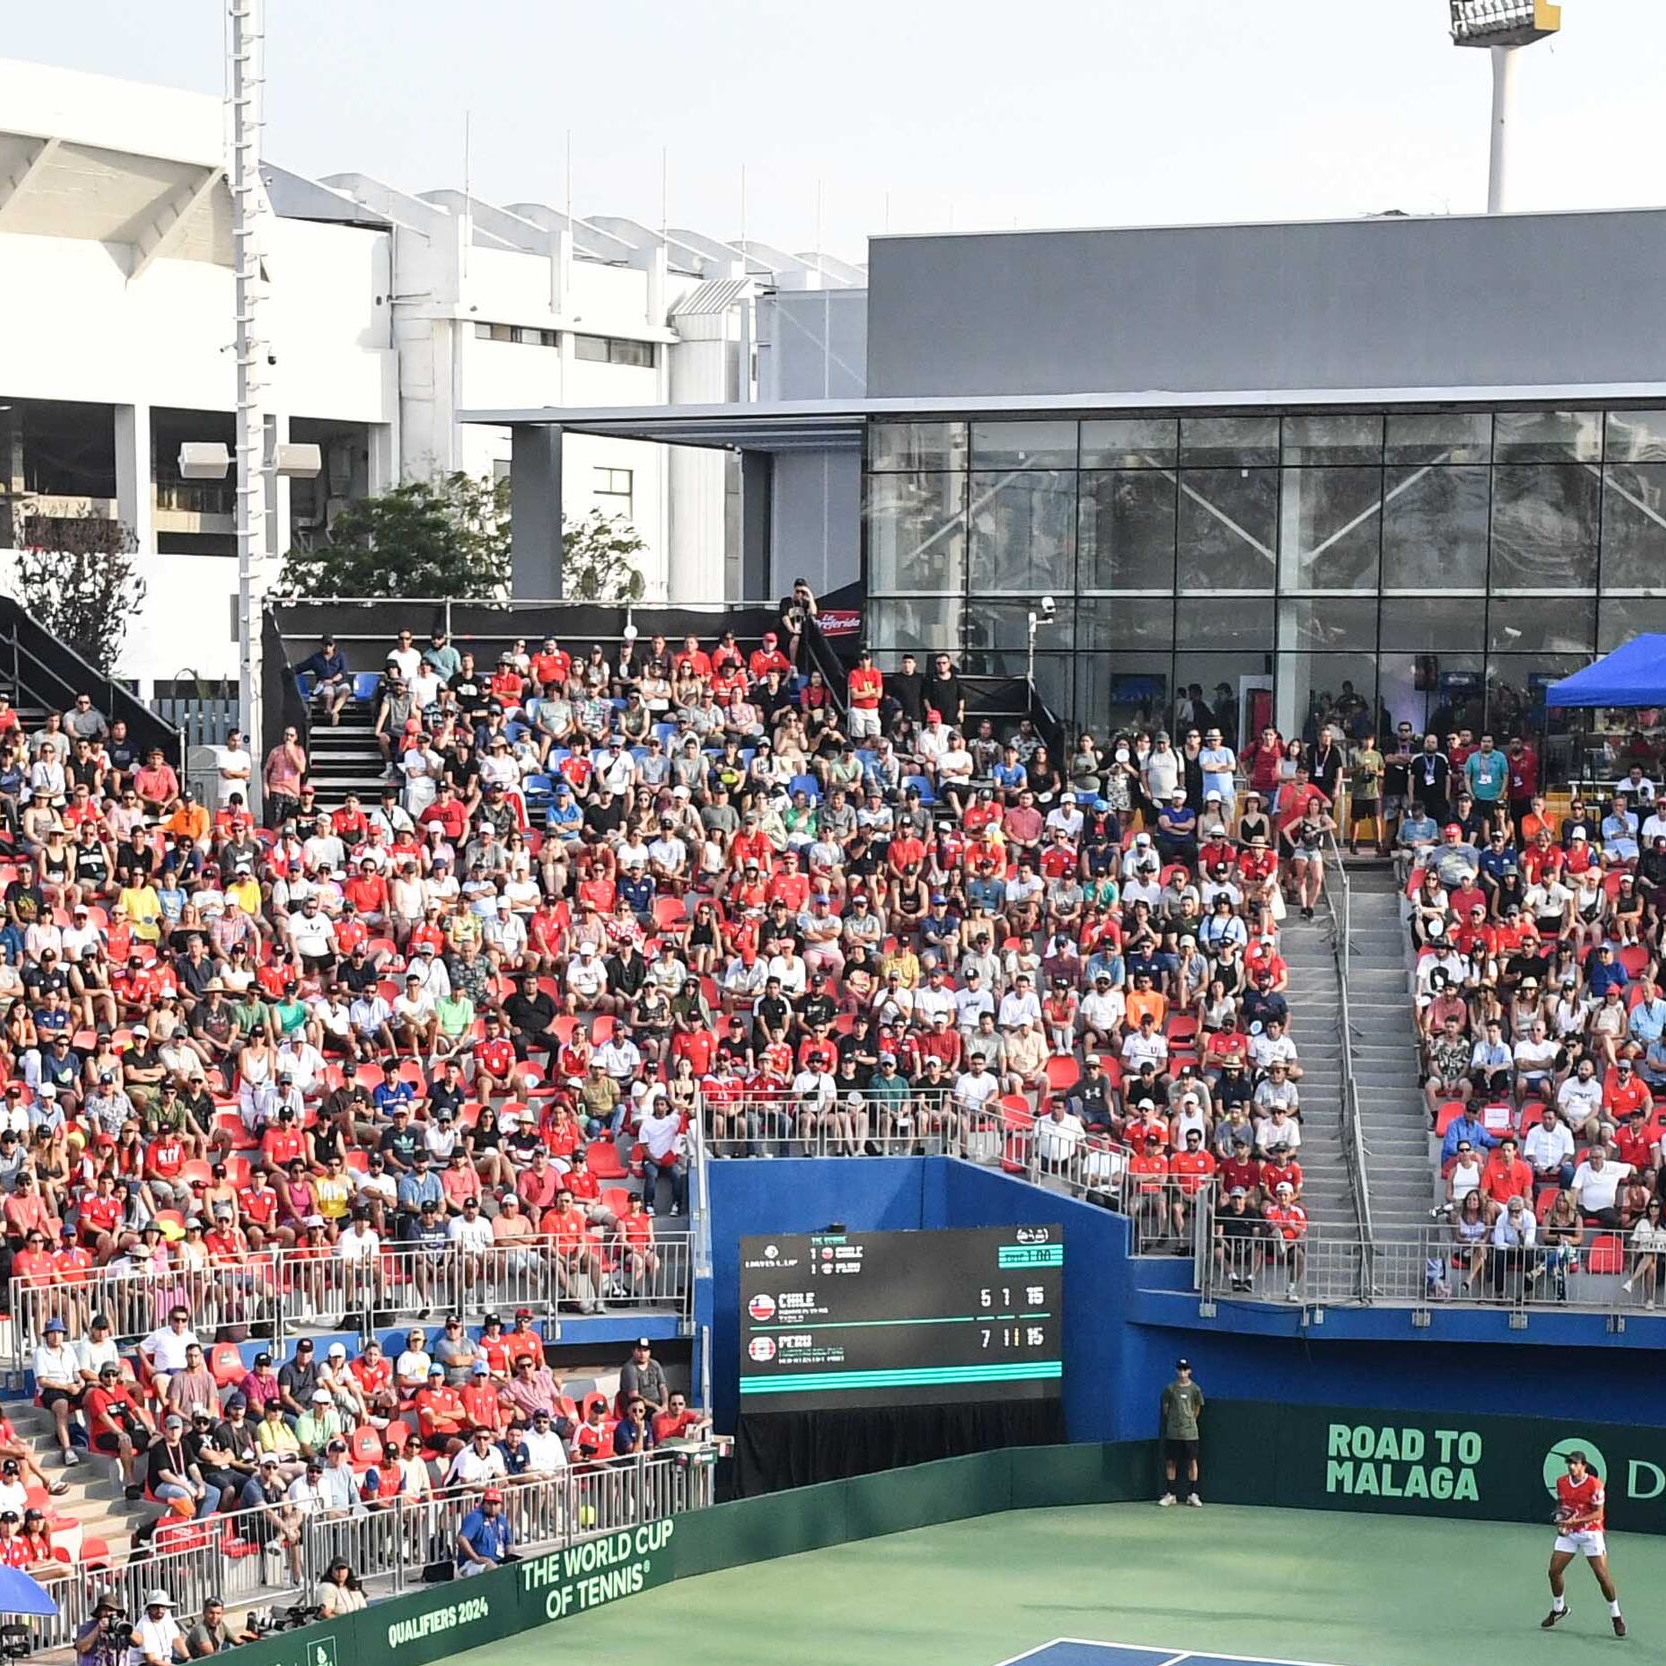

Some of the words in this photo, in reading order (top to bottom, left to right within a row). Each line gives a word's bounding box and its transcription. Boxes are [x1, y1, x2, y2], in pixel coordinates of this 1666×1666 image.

[778, 1292, 814, 1309] CHILE
[981, 1289, 991, 1307] 5
[1002, 1288, 1010, 1306] 1
[1026, 1286, 1044, 1305] 15
[778, 1334, 812, 1348] PERU
[981, 1329, 991, 1348] 7
[1026, 1327, 1044, 1346] 15
[1328, 1424, 1425, 1461] ROAD
[1435, 1430, 1482, 1465] TO
[1326, 1461, 1480, 1501] MALAGA
[522, 1556, 562, 1592] THE
[563, 1531, 633, 1580] WORLD
[636, 1518, 675, 1555] CUP
[388, 1607, 457, 1649] QUALIFIERS
[458, 1596, 489, 1627] 2024
[546, 1590, 575, 1620] OF
